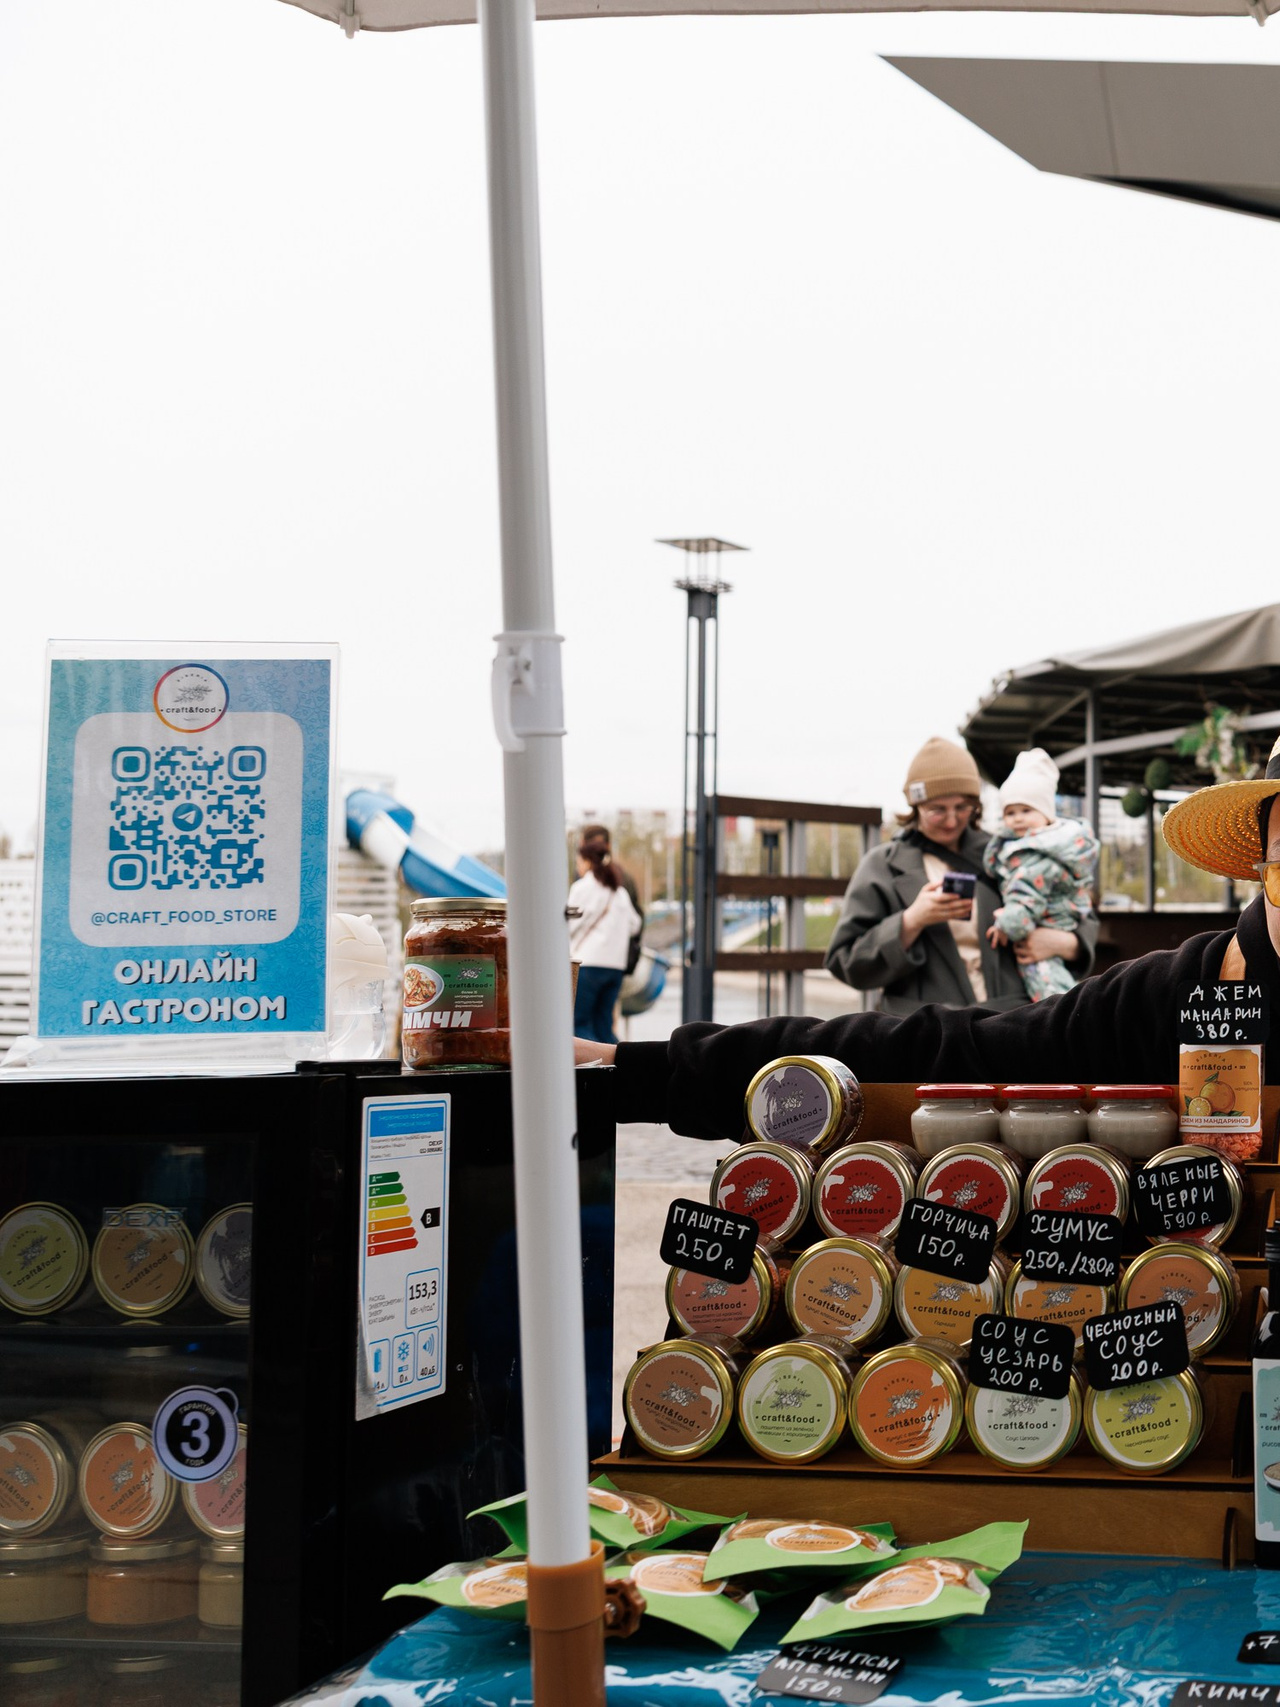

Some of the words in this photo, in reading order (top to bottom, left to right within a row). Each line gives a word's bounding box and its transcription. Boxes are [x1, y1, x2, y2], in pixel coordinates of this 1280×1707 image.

[165, 706, 216, 714] craft&food
[91, 909, 277, 926] @CRAFT_FOOD_STORE
[114, 951, 257, 985] ОНЛАЙН
[1188, 984, 1262, 1003] ДЖЕМ
[82, 995, 287, 1026] ГАСТРОНОМ
[403, 1010, 473, 1029] ИМЧИ
[1180, 1007, 1262, 1024] МАНДАРИН
[1195, 1022, 1230, 1040] 380
[772, 1108, 818, 1130] craft&food
[1137, 1162, 1220, 1190] ВЯЛЕНЫЕ
[747, 1195, 784, 1217] aft&food
[1150, 1185, 1214, 1212] ЧЕРРИ
[104, 1209, 183, 1228] DEXP
[425, 1213, 432, 1225] B
[835, 1206, 885, 1215] craft&food
[1163, 1211, 1196, 1230] 590
[672, 1205, 751, 1240] ПАШТЕТ
[909, 1203, 990, 1241] ГОРЧИЦА
[1030, 1213, 1114, 1244] ХУМУС
[16, 1251, 63, 1287] craft&food
[409, 1280, 437, 1301] 153,3
[692, 1301, 741, 1312] craft&food
[807, 1295, 857, 1322] craft&food
[917, 1305, 971, 1318] craft&food
[1085, 1303, 1177, 1342] ЧЕСНОЧНЫЙ
[980, 1320, 1050, 1347] СОУС
[1099, 1329, 1164, 1360] СОУС
[979, 1345, 1064, 1373] ЦЕЗАРЬ
[988, 1368, 1023, 1387] 200
[645, 1398, 696, 1427] craft&food
[761, 1414, 815, 1424] craft&food
[878, 1412, 934, 1433] craft&food
[181, 1411, 210, 1459] 3
[992, 1421, 1048, 1430] craft&food
[1114, 1418, 1172, 1439] craft&food
